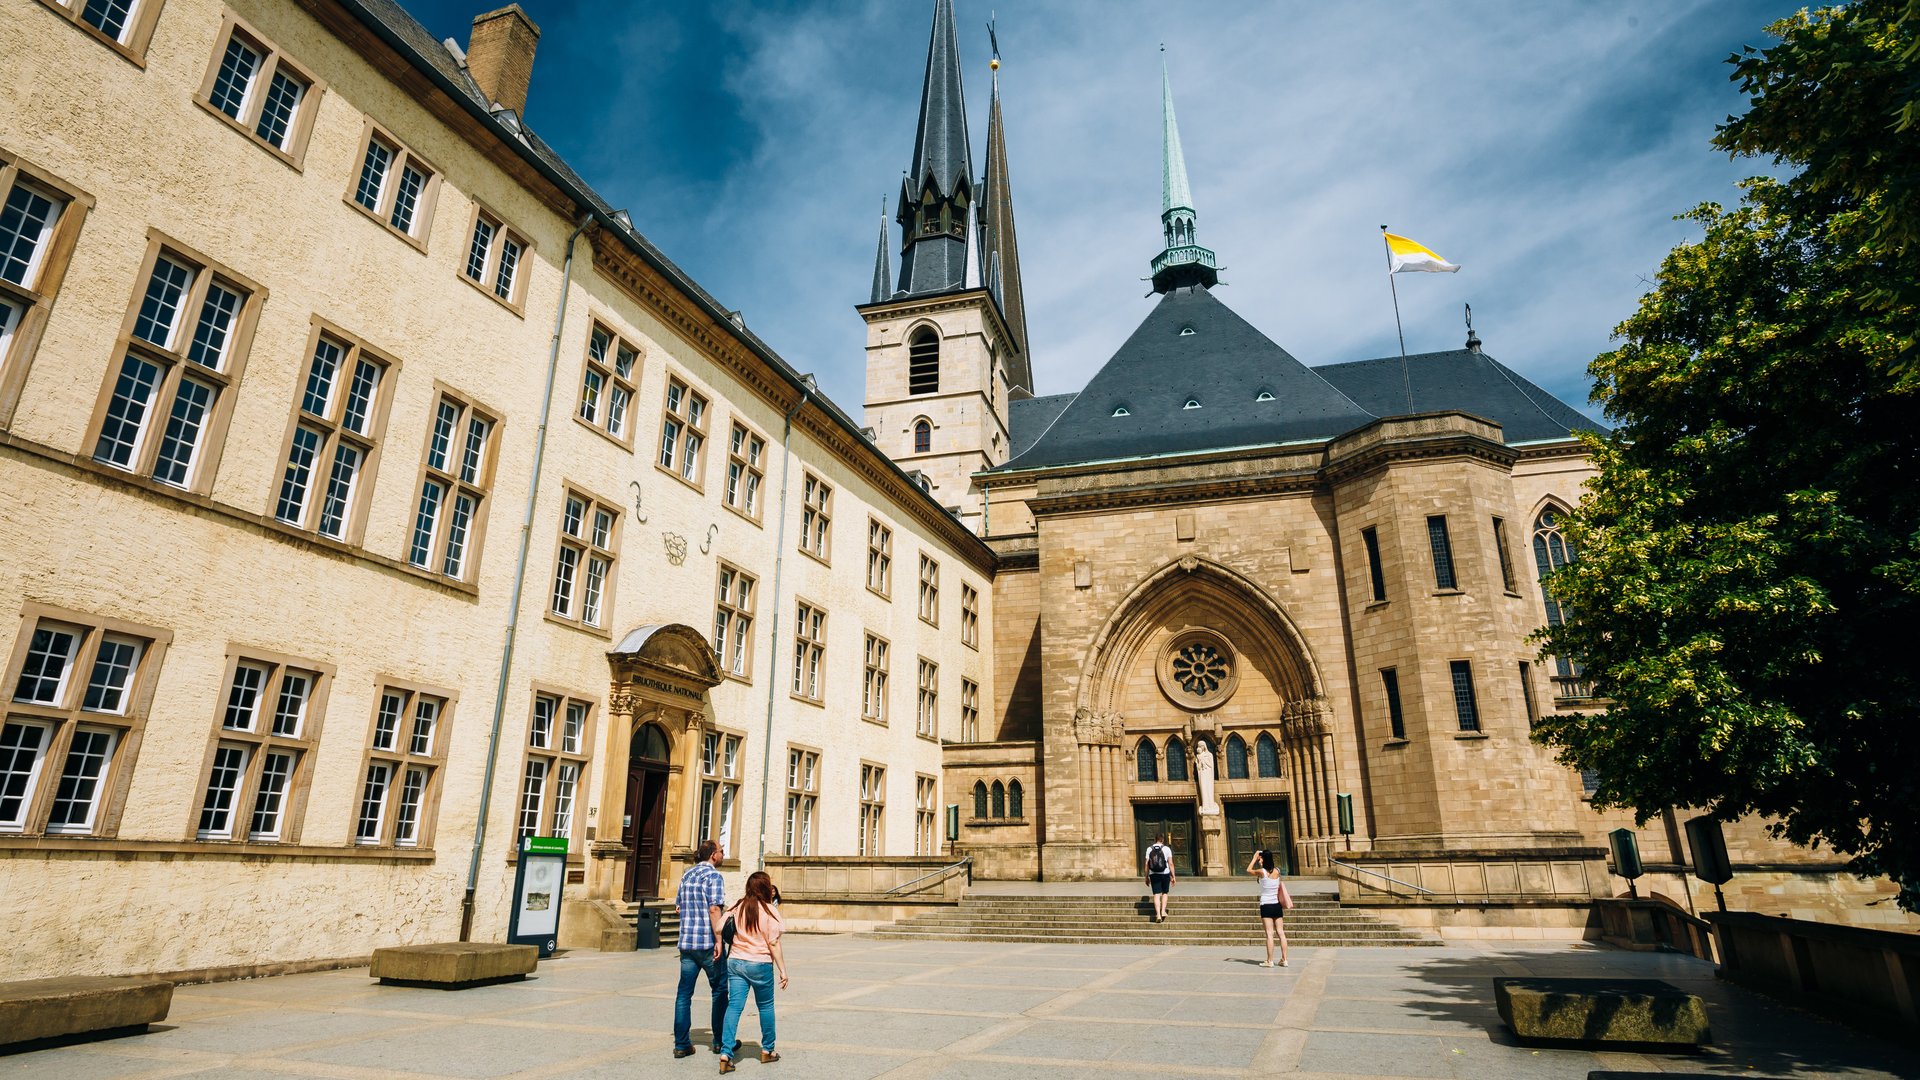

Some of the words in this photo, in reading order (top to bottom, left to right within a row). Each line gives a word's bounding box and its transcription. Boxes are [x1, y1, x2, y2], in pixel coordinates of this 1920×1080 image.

[632, 674, 672, 692] BIBLIOTHEQUE
[674, 686, 703, 701] NATIONALE
[524, 837, 532, 850] B
